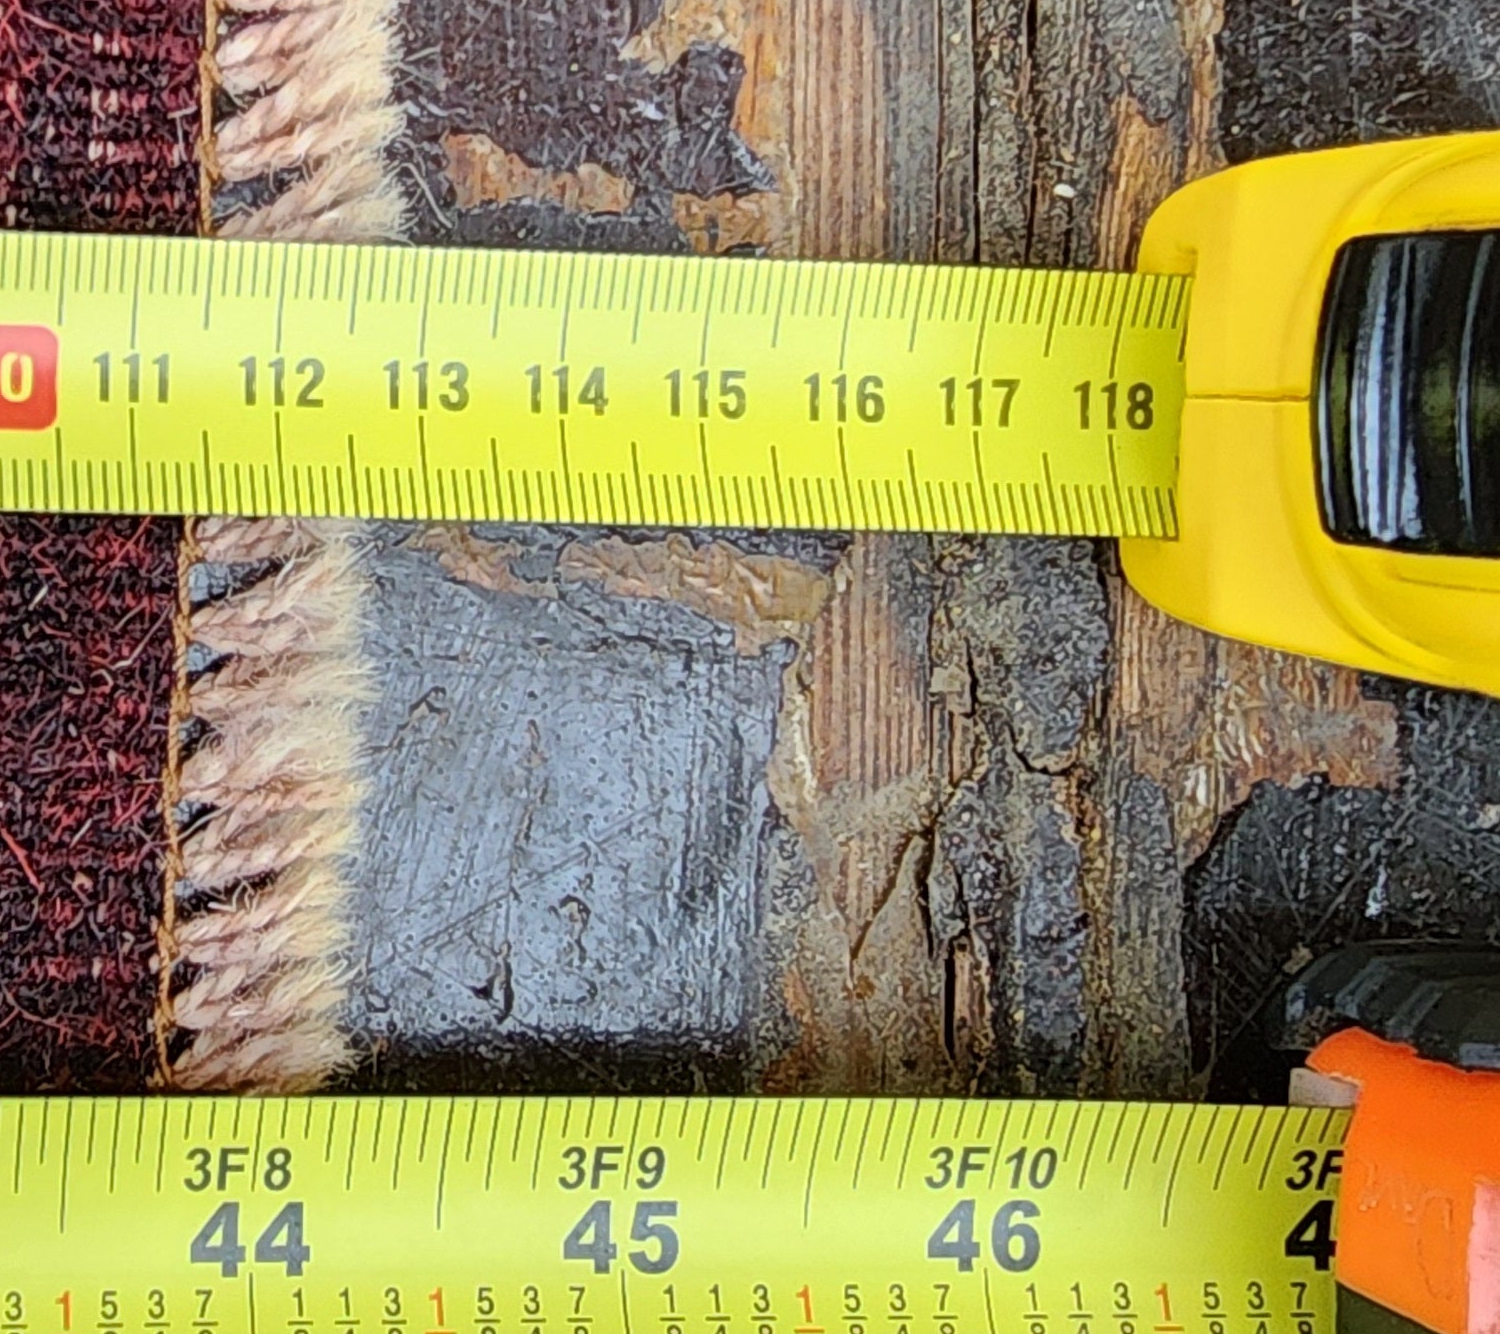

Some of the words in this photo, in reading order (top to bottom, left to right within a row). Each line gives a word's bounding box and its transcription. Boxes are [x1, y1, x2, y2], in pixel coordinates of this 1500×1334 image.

[93, 352, 168, 403] 111
[240, 357, 324, 407] 112
[384, 361, 469, 411] 113
[526, 365, 608, 415] 114
[665, 370, 745, 419] 115
[805, 373, 884, 422] 116
[940, 377, 1020, 427] 117
[1074, 381, 1153, 430] 118
[190, 1201, 310, 1278] 44
[563, 1200, 679, 1274] 45
[927, 1199, 1041, 1272] 46
